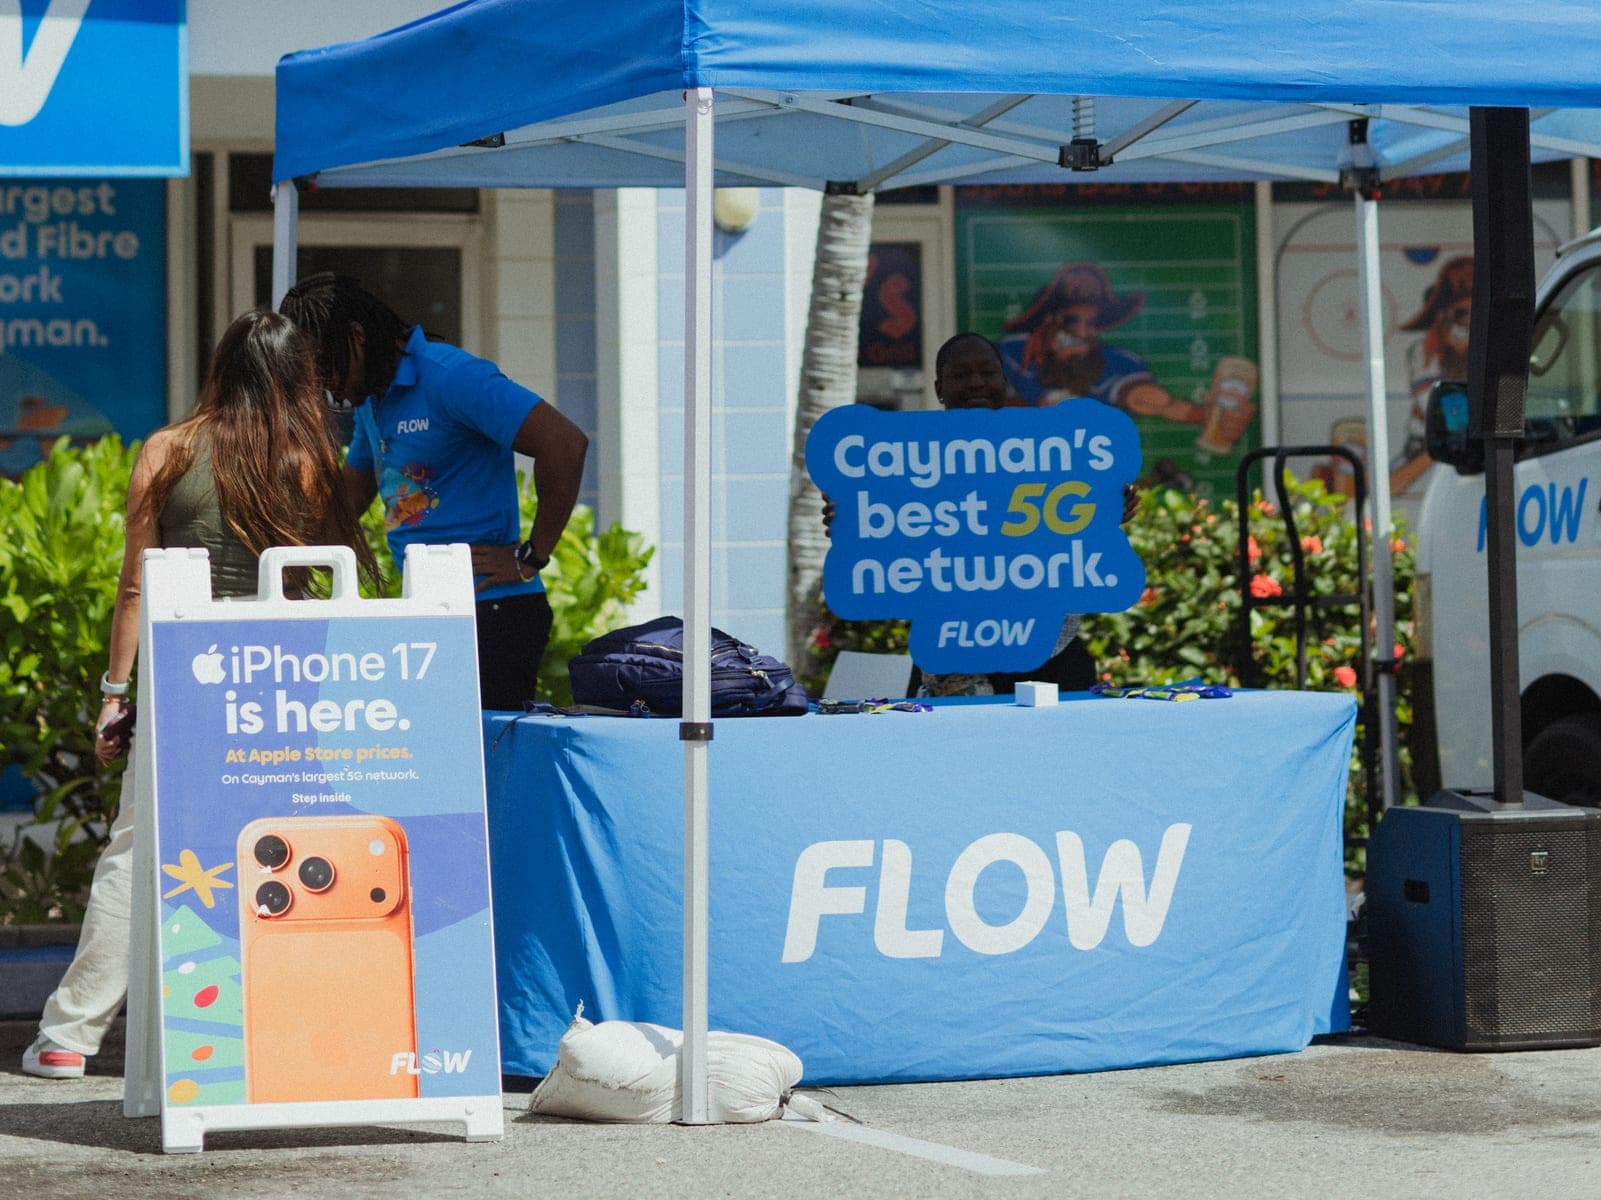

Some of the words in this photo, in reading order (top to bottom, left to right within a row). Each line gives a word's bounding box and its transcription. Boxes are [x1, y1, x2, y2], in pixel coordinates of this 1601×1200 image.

[0, 183, 116, 223] rgest
[37, 222, 139, 259] Fibre
[0, 319, 108, 349] man.
[397, 418, 429, 434] FLOW
[833, 429, 1115, 488] Cayman's
[857, 490, 989, 538] best
[1000, 481, 1096, 537] 5G
[1477, 477, 1588, 552] OW
[852, 539, 1118, 594] network.
[938, 618, 1035, 648] FLOW
[232, 645, 386, 684] iPhone
[391, 642, 437, 681] 17
[225, 691, 264, 734] is
[276, 689, 411, 733] here.
[225, 748, 247, 763] At
[249, 745, 301, 766] Apple
[305, 745, 353, 762] Store
[356, 742, 415, 762] prices.
[222, 774, 240, 785] On
[242, 771, 300, 786] Cayman's
[302, 769, 345, 784] largest
[347, 770, 364, 781] 5G
[365, 768, 420, 782] network.
[292, 792, 318, 805] Step
[319, 791, 352, 803] inside
[782, 822, 1193, 964] FLOW
[389, 1049, 473, 1076] FLOW
